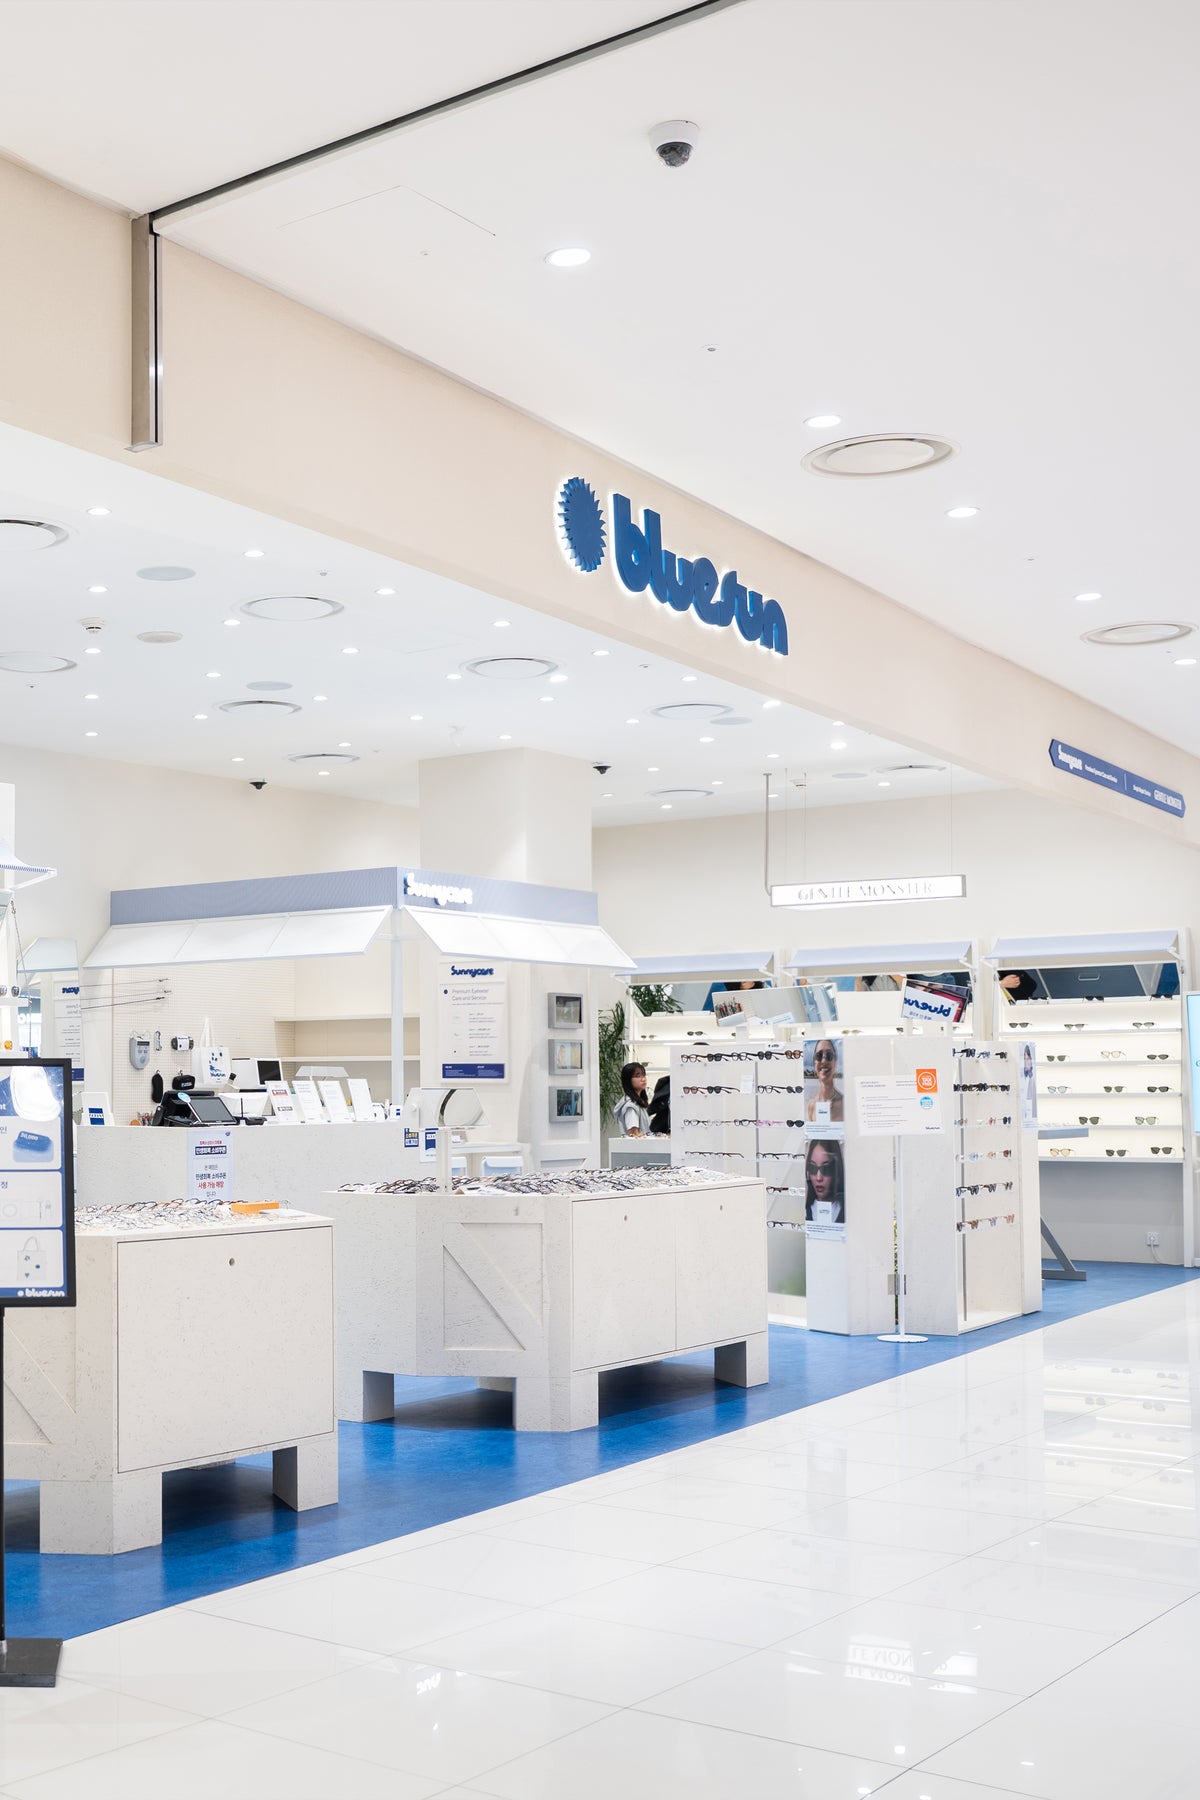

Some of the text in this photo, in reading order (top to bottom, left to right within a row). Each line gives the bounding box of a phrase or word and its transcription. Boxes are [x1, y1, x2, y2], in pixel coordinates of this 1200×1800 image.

[613, 493, 788, 656] bluesun
[798, 881, 932, 900] GENTLE MONSTER
[25, 1288, 65, 1297] bluesun
